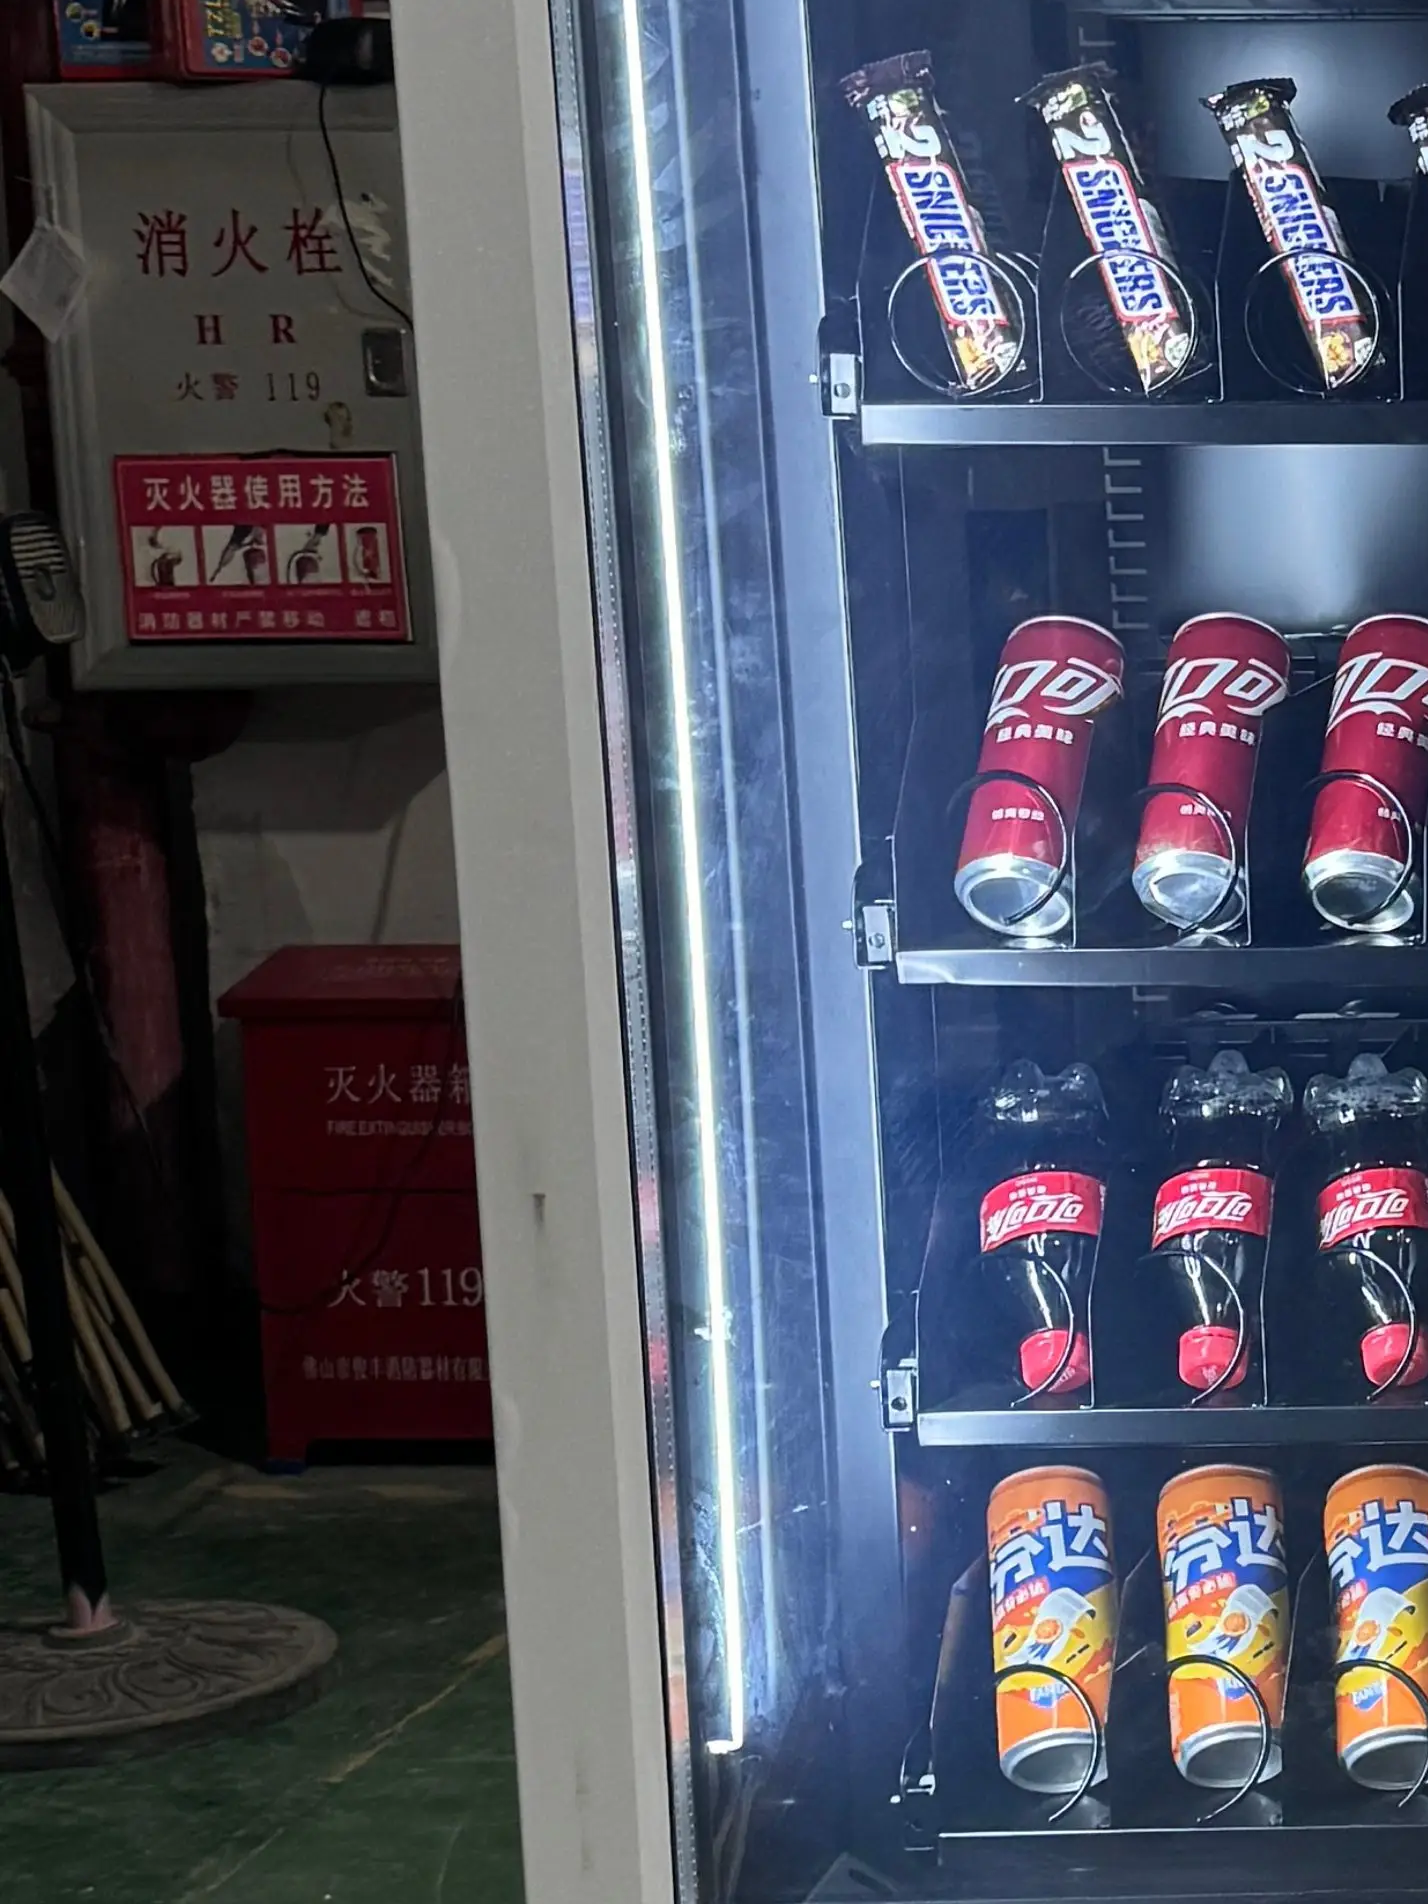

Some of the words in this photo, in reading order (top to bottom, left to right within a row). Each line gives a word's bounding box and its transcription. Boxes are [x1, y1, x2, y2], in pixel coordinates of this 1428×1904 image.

[133, 207, 343, 277] 消火栓
[194, 314, 224, 345] H
[268, 314, 297, 344] R
[176, 372, 239, 401] 火警
[265, 371, 321, 401] 119
[142, 472, 370, 512] 灭火器使用方法
